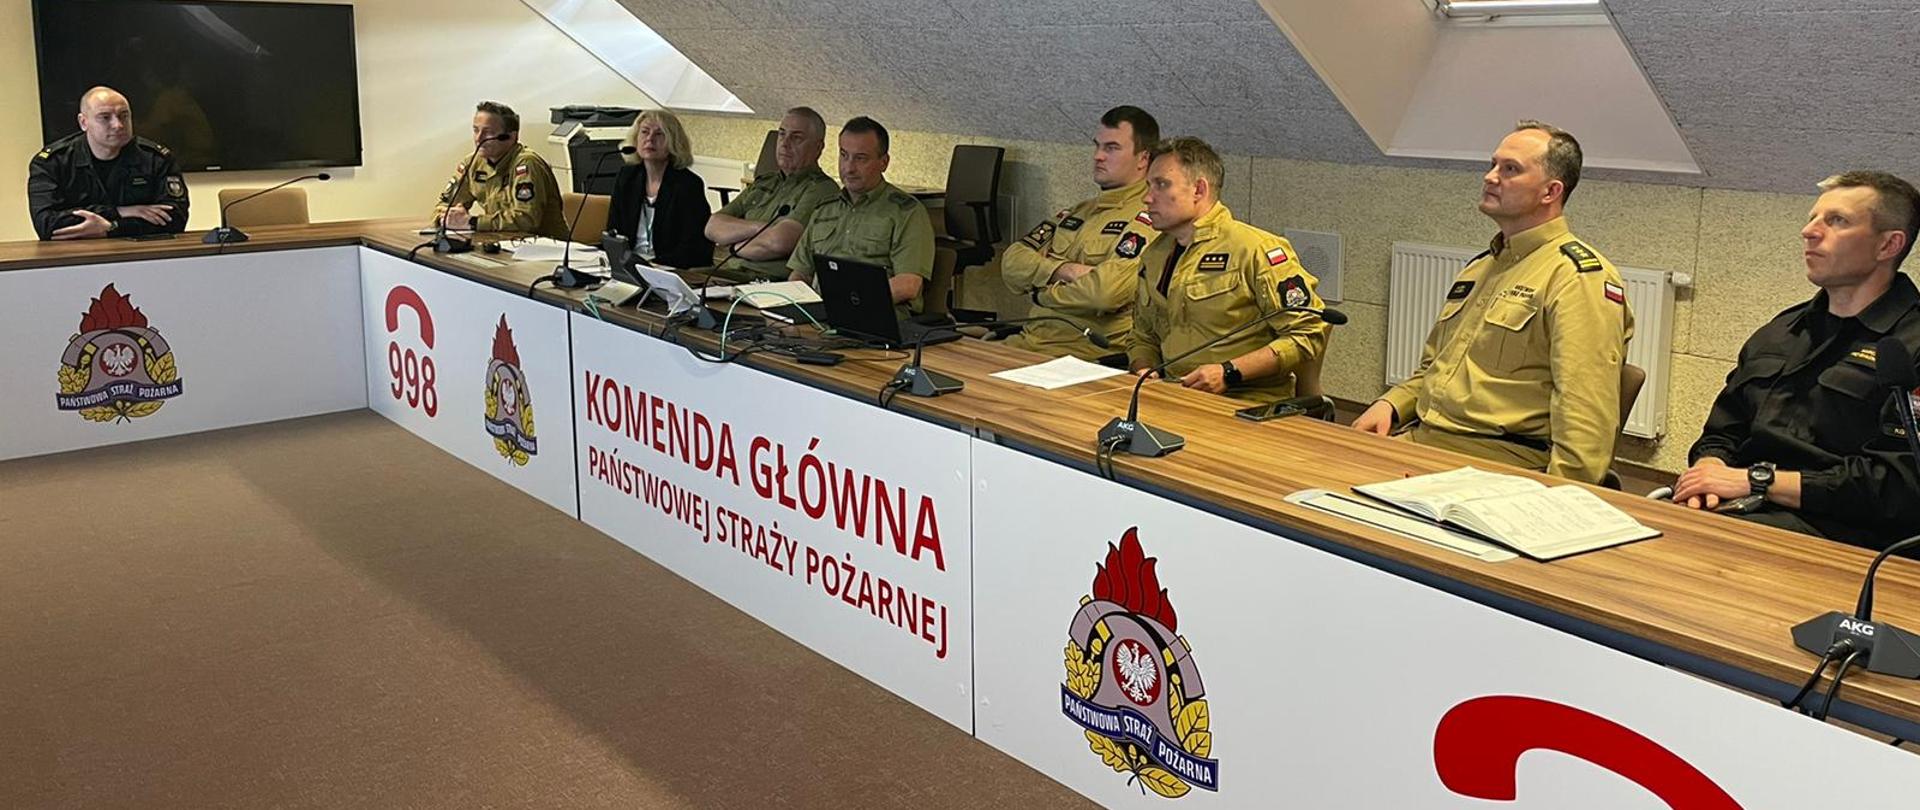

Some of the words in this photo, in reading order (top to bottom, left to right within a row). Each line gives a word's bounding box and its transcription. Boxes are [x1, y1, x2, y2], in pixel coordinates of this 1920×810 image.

[389, 341, 438, 418] 998
[1117, 421, 1134, 431] AKG
[585, 370, 740, 487] KOMENDA
[749, 437, 946, 572] GŁÓWNA
[589, 445, 711, 544] PAŃSTWOWEJ
[716, 505, 798, 577] STRAŻY
[806, 545, 948, 659] POŻARNEJ
[1839, 619, 1875, 636] AKG
[1064, 693, 1121, 732] PAŃSTWOWA
[1123, 713, 1153, 745] STRAŻ
[1158, 742, 1213, 784] POŻARNA
